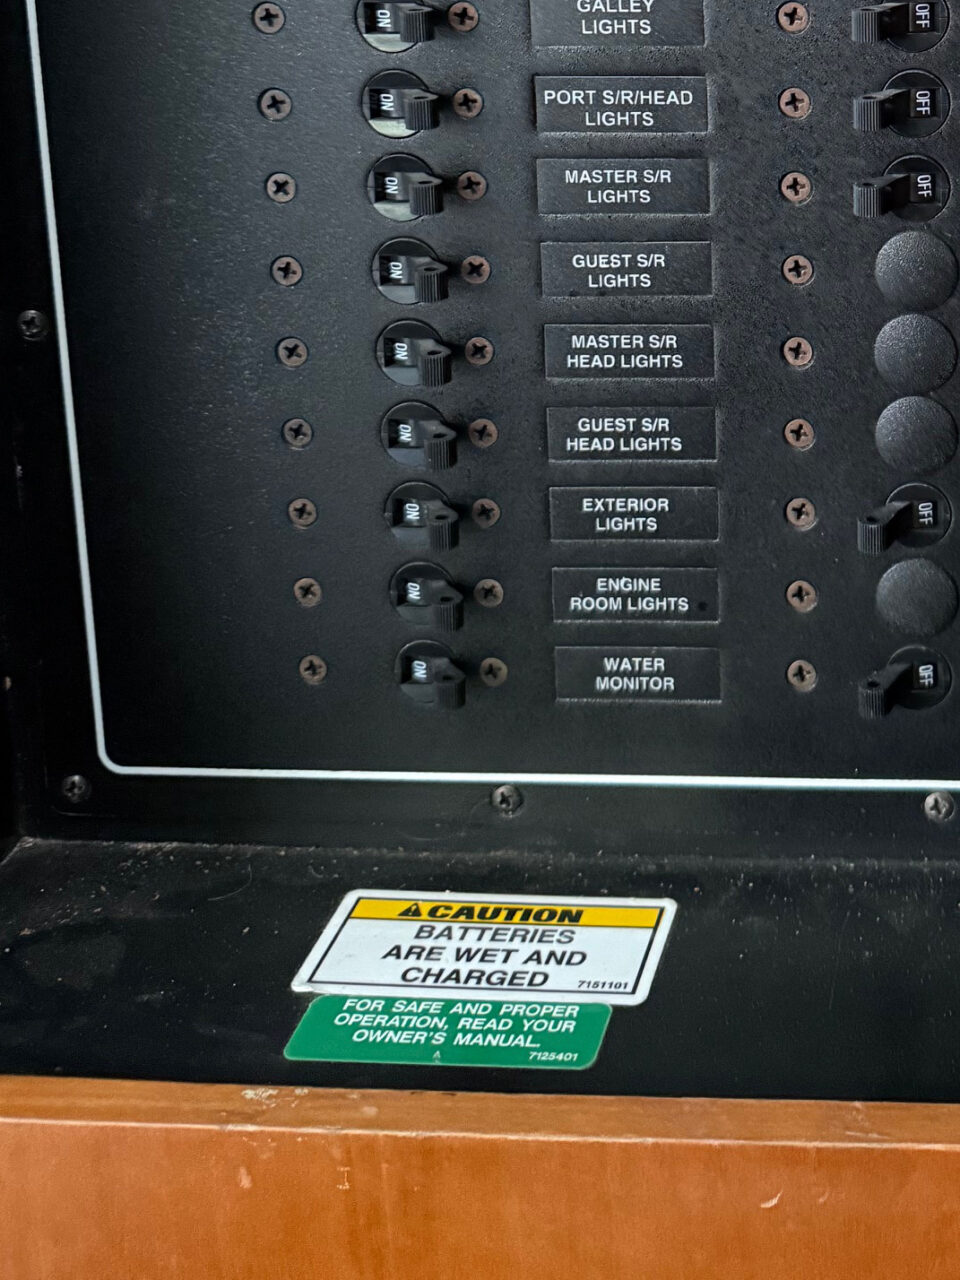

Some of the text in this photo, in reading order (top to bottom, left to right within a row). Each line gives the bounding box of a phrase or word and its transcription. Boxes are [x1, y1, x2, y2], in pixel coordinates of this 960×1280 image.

[377, 9, 391, 28] ON
[915, 3, 929, 29] OFF
[581, 20, 651, 35] LIGHTS
[381, 93, 394, 111] ON
[544, 90, 693, 106] PORT S/R/HEAD
[916, 90, 930, 115] OFF
[584, 111, 654, 126] LIGHTS
[565, 170, 672, 184] MASTER S/R
[385, 177, 399, 195] ON
[916, 174, 931, 199] OFF
[587, 189, 651, 204] LIGHTS
[572, 254, 666, 269] GUEST S/R
[390, 262, 403, 280] ON
[588, 273, 652, 288] LIGHTS
[571, 335, 678, 349] MASTER S/R
[394, 342, 408, 360] ON
[567, 354, 684, 369] HEAD LIGHTS
[400, 424, 412, 441] ON
[577, 418, 670, 432] GUEST S/R
[566, 437, 683, 452] HEAD LIGHTS
[406, 503, 420, 519] ON
[582, 498, 669, 512] EXTERIOR
[918, 502, 932, 525] OFF
[596, 517, 658, 532] LIGHTS
[408, 583, 421, 600] ON
[597, 578, 662, 592] ENGINE
[570, 596, 689, 612] ROOM LIGHTS
[412, 661, 427, 678] ON
[604, 658, 665, 672] WATER
[596, 676, 675, 691] MONITOR
[918, 665, 933, 688] OFF
[425, 905, 584, 923] CAUTION
[413, 925, 576, 944] BATTERIES
[382, 946, 587, 966] ARE WET AND
[401, 967, 550, 987] CHARGED
[577, 980, 629, 990] 7151101
[343, 999, 580, 1018] FOR SAFE AND PROPER
[334, 1013, 576, 1033] OPERATION, READ YOUR
[352, 1030, 541, 1048] OWNER'S MANUAL.
[529, 1051, 578, 1062] 7125401
